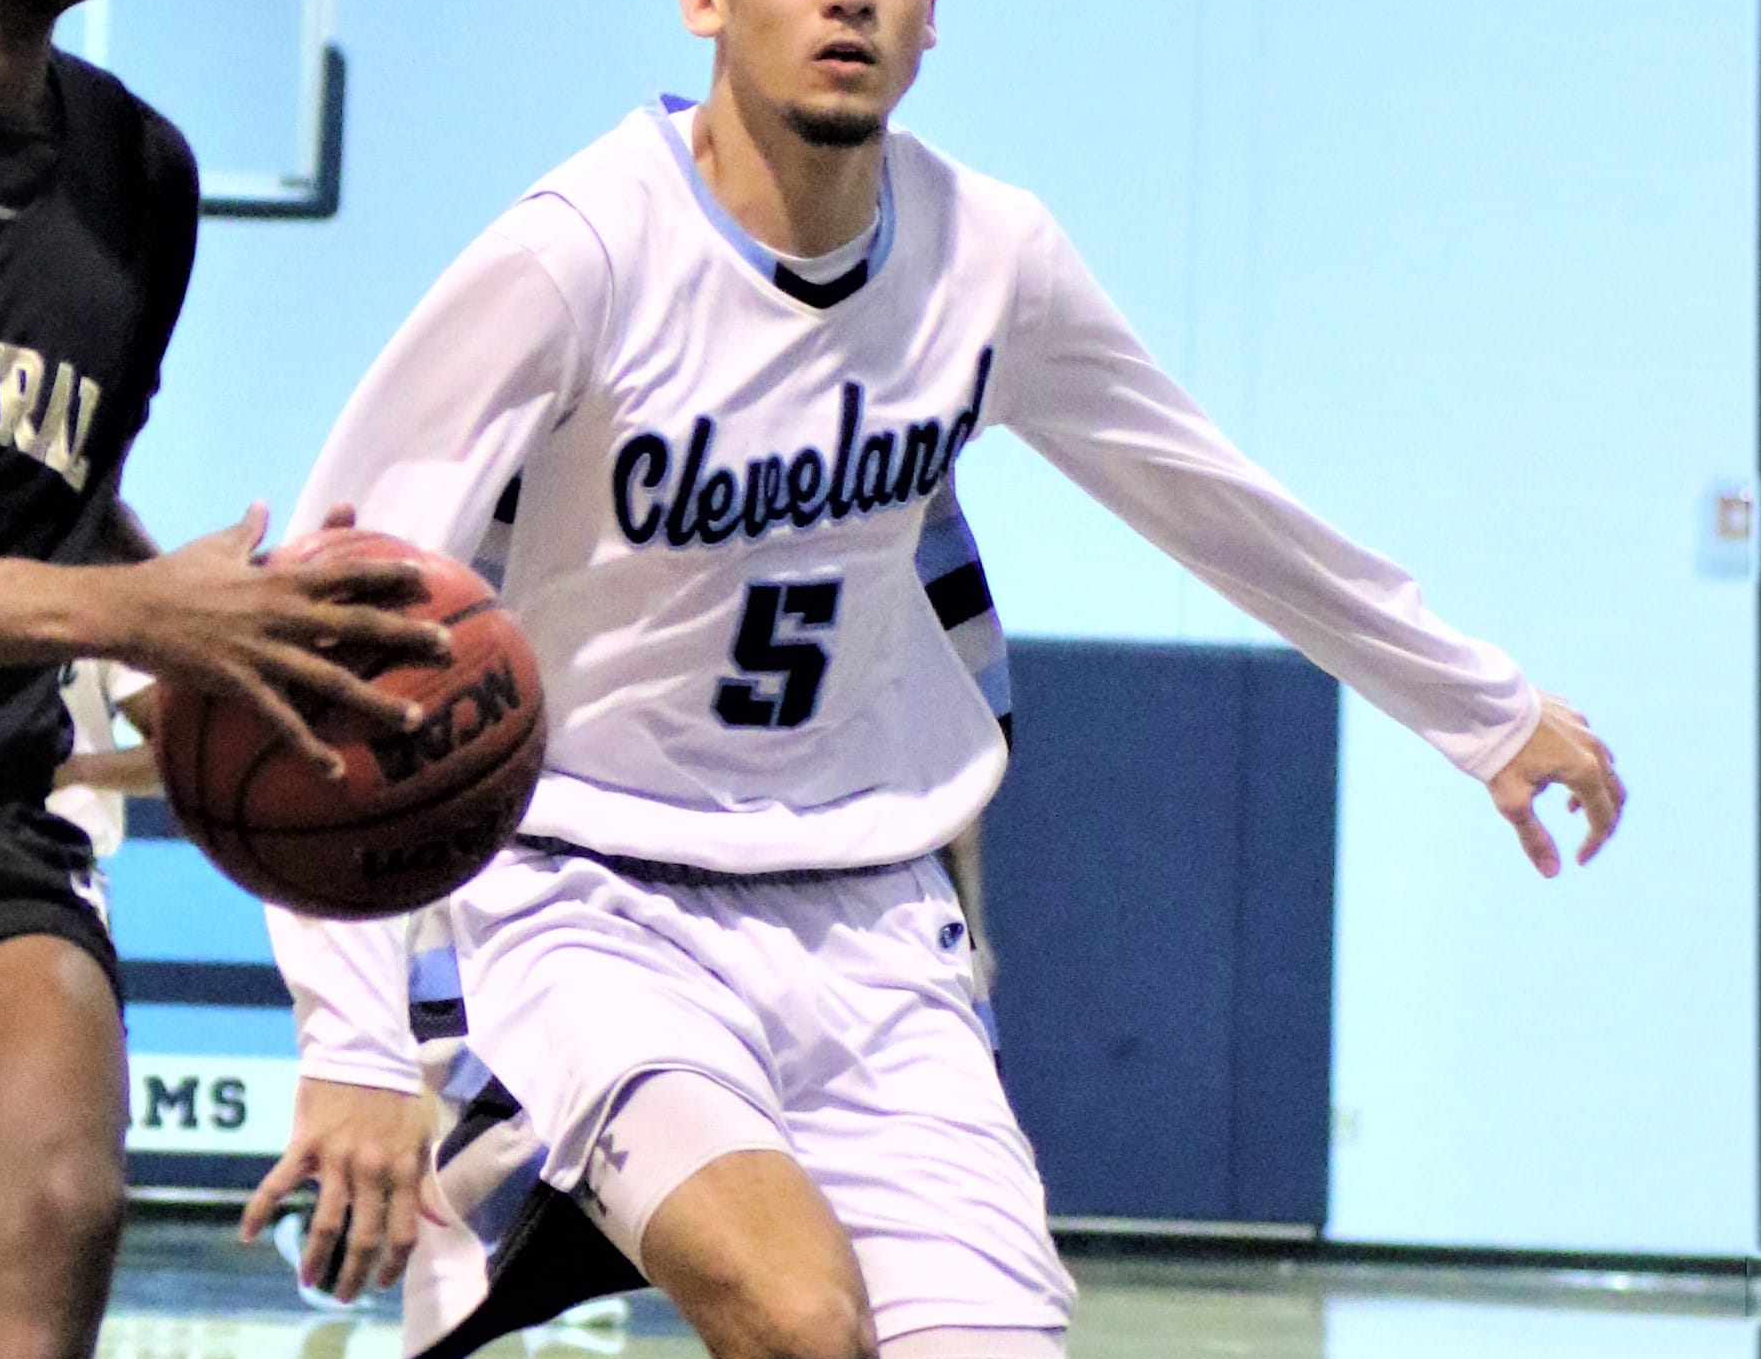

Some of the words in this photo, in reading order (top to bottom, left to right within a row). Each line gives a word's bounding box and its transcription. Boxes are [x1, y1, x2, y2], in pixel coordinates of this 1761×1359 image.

[611, 343, 996, 549] Cleveland
[711, 576, 845, 729] 5
[128, 1074, 248, 1130] MS
